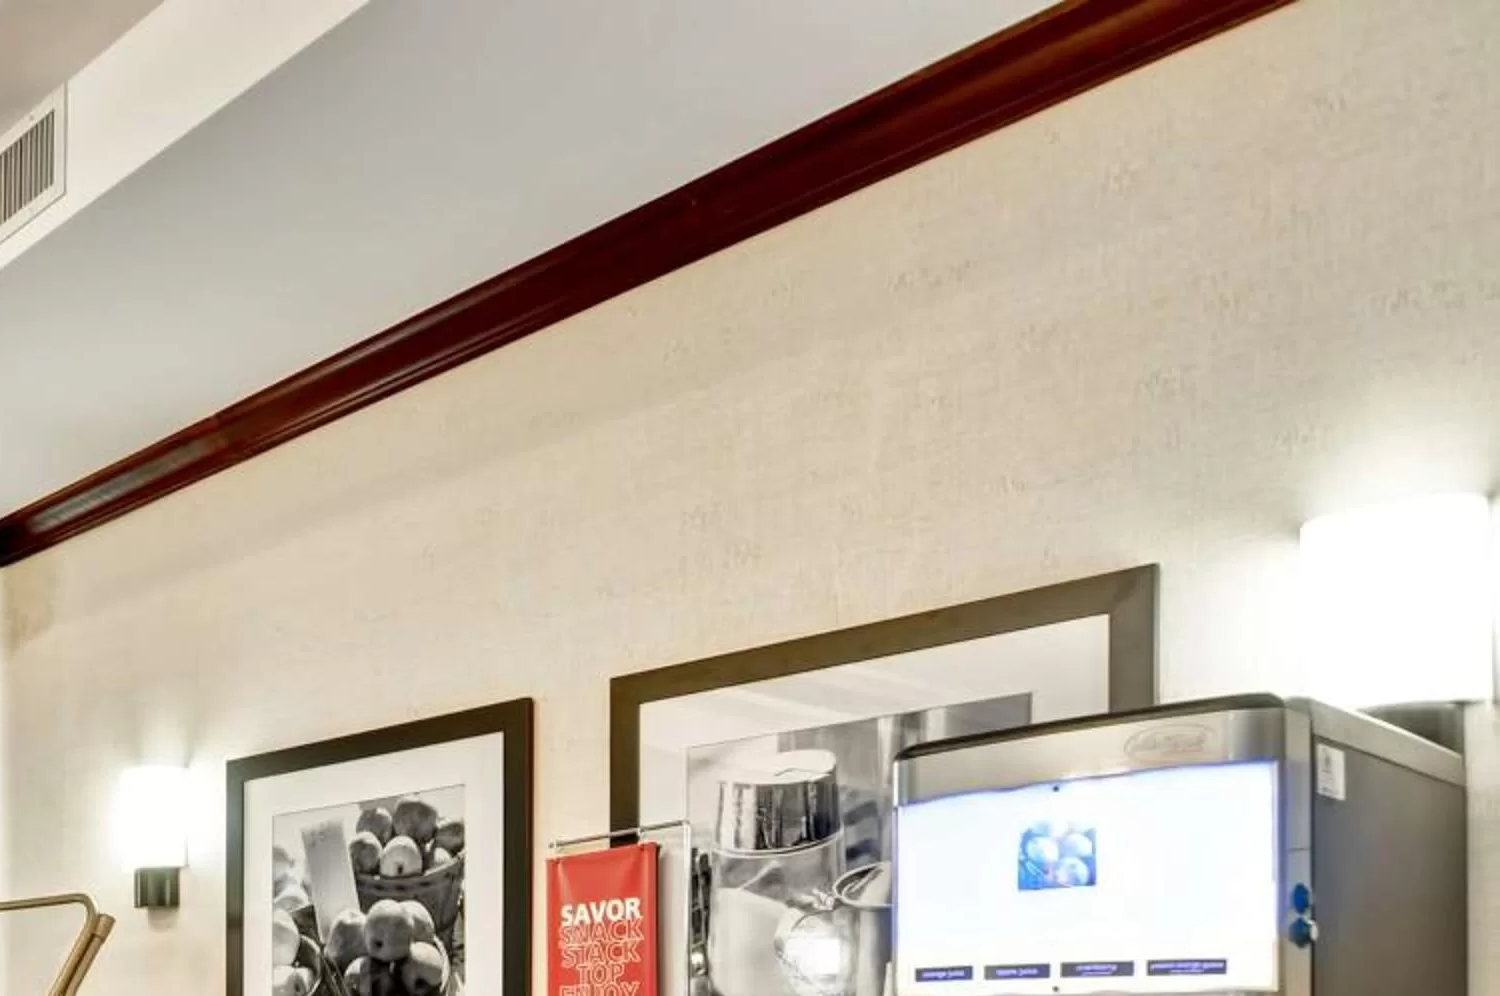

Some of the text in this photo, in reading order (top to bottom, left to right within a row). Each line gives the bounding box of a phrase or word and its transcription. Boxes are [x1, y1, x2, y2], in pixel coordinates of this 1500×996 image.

[561, 897, 643, 927] SAVOR
[560, 919, 644, 944] SNACK
[559, 940, 641, 968] STACK
[576, 962, 625, 984] TOP
